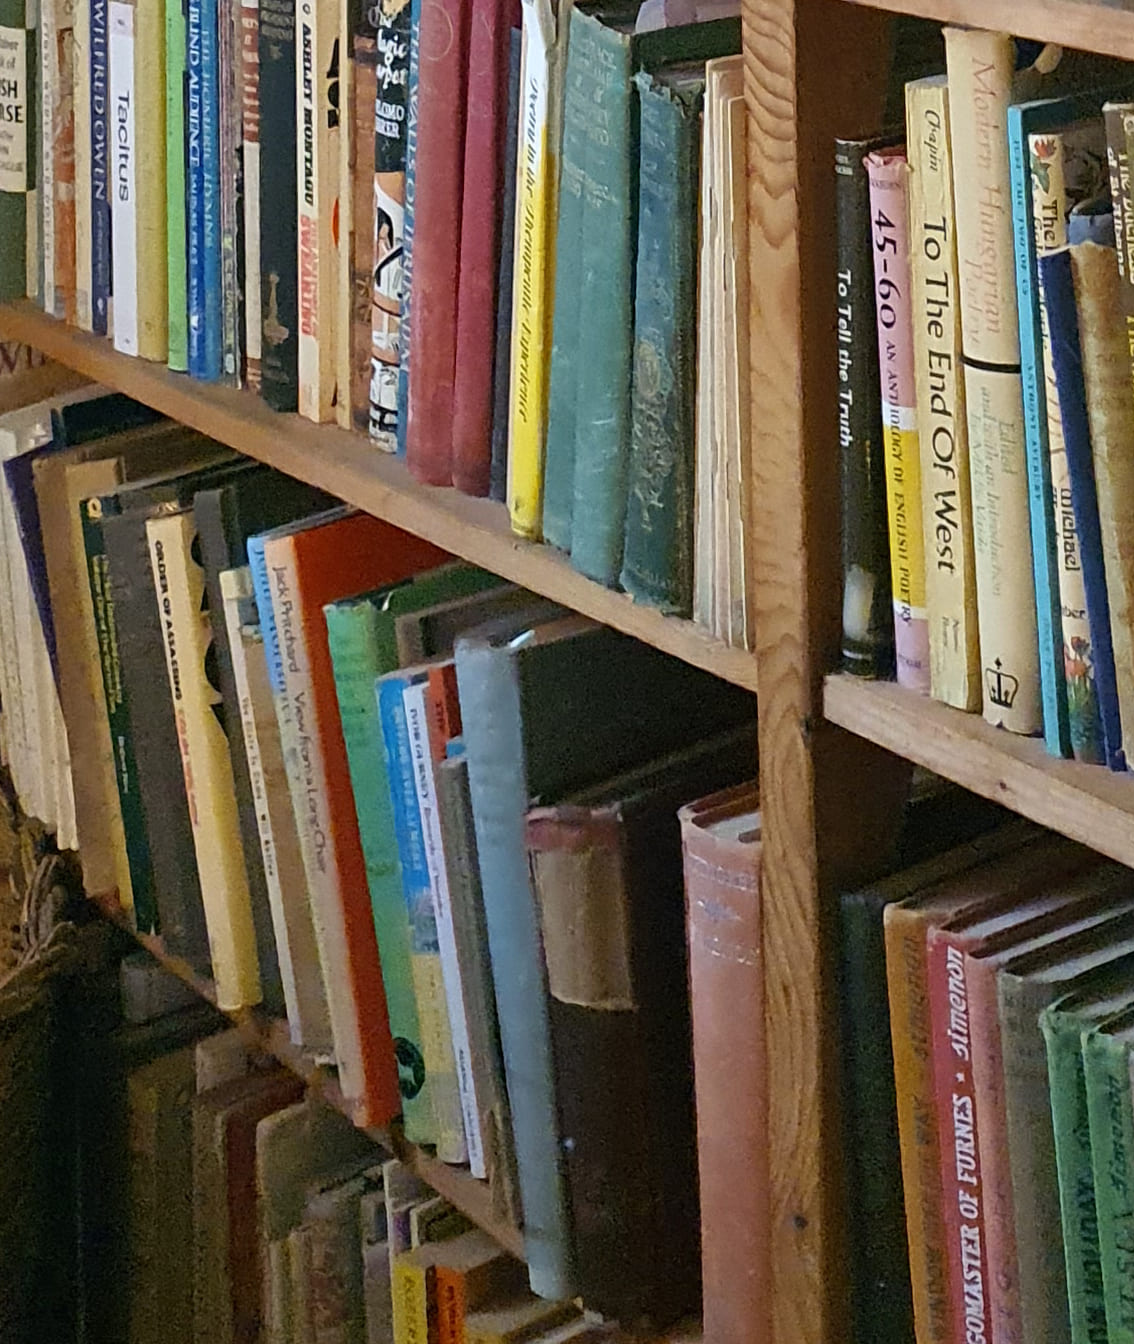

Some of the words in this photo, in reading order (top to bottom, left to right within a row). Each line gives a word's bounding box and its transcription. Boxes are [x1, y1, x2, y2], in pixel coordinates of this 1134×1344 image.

[301, 21, 314, 99] ASHLEY
[91, 120, 106, 202] OWEN
[116, 90, 130, 202] Tacitus
[302, 107, 316, 207] MONTAGU
[922, 213, 949, 262] To
[924, 268, 950, 338] The
[926, 346, 954, 415] End
[930, 421, 956, 477] Of
[152, 539, 167, 593] ORDER
[932, 483, 959, 575] West
[945, 945, 969, 1060] Simenon
[952, 1095, 981, 1186] FURNES
[957, 1186, 980, 1225] OF
